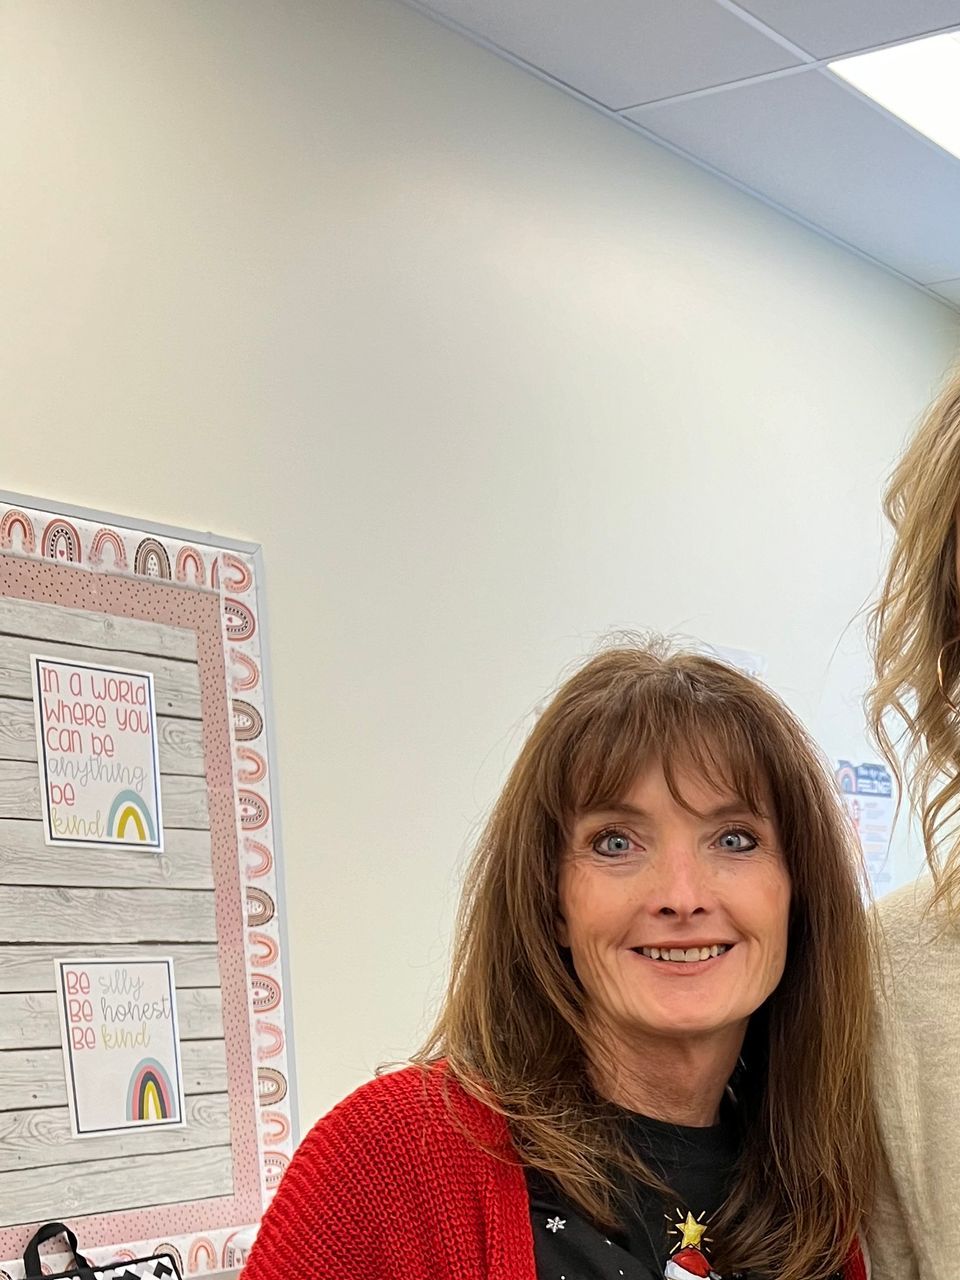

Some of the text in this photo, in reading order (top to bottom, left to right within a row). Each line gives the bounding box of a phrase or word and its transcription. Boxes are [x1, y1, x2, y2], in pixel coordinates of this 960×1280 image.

[41, 667, 59, 693] In
[70, 672, 82, 696] a
[92, 732, 114, 757] be
[48, 756, 147, 792] anything
[51, 781, 75, 806] be
[52, 807, 105, 838] kind
[98, 968, 144, 1001] silly
[101, 995, 171, 1022] honest
[101, 1021, 150, 1050] kind
